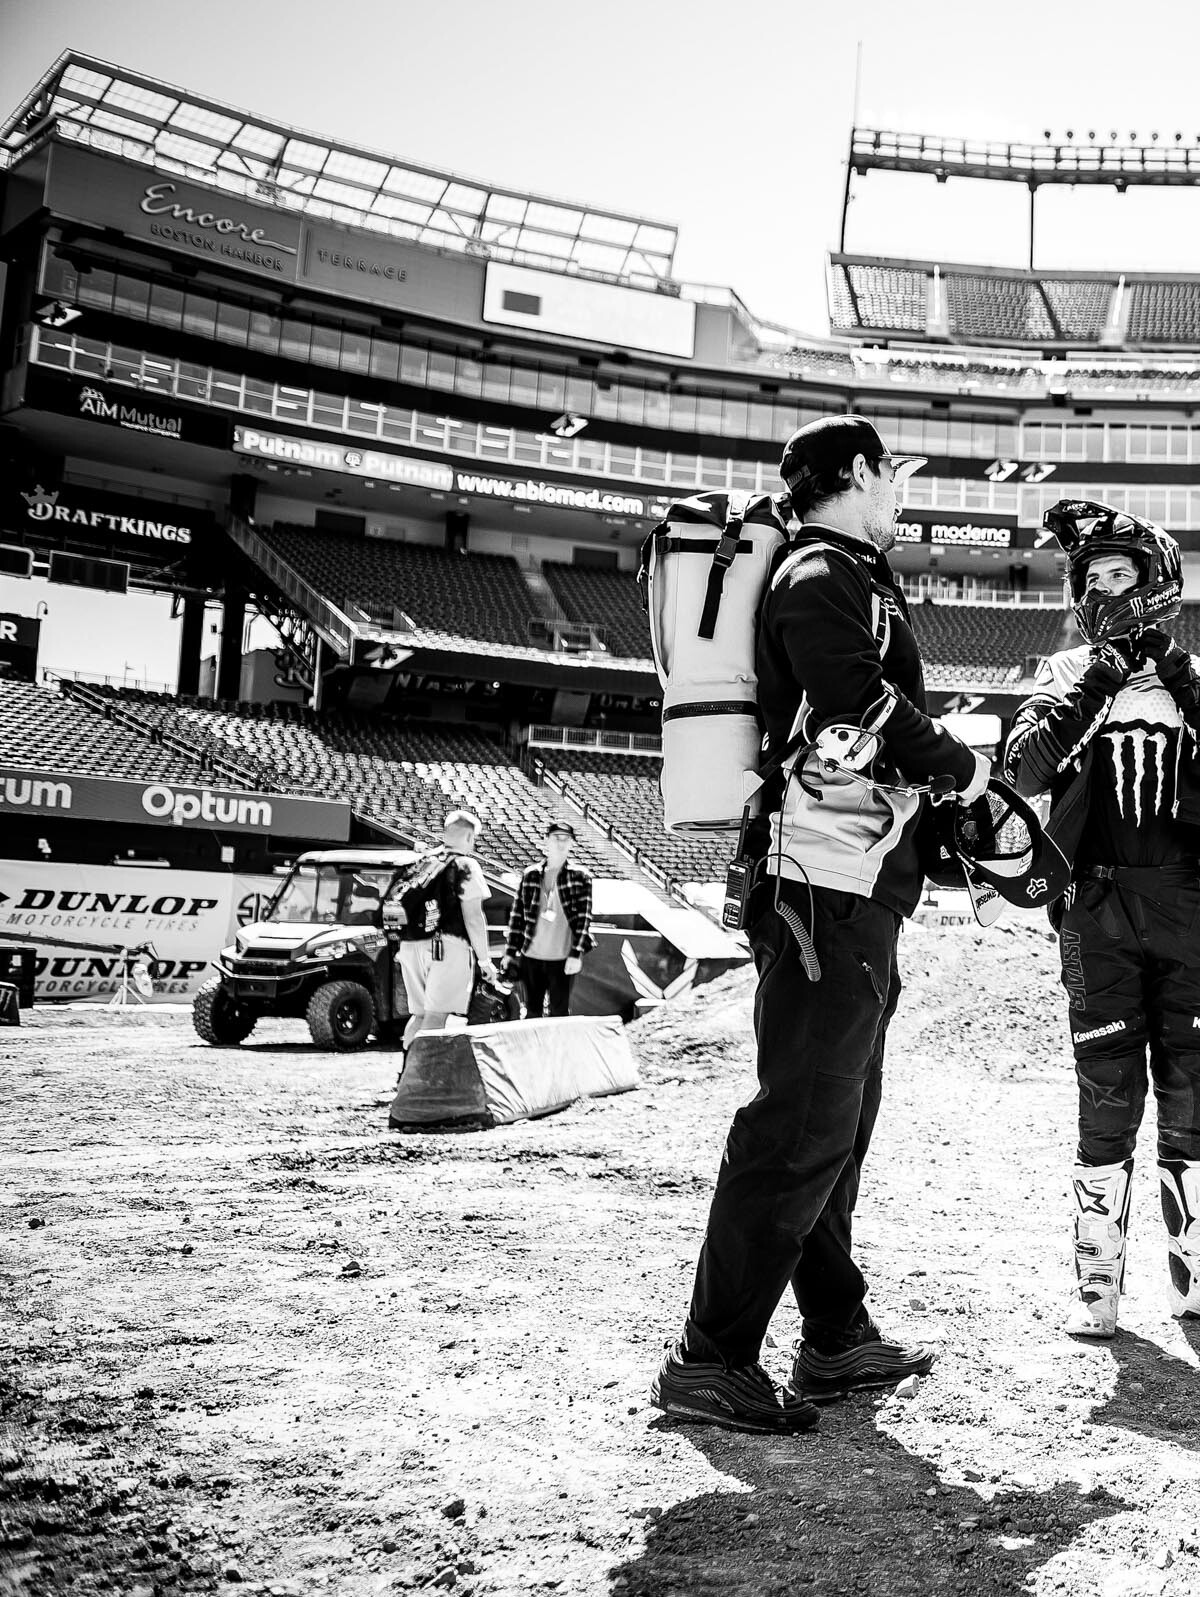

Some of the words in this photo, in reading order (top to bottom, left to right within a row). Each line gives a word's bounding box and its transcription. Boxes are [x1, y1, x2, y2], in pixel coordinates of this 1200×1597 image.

[140, 183, 297, 255] Encore
[150, 223, 215, 252] BOSTON
[220, 243, 284, 272] HARBOR
[318, 248, 408, 282] TERRACE
[120, 405, 182, 432] Mutual
[243, 430, 339, 466] Putnam
[364, 453, 452, 488] Putnam
[456, 473, 644, 515] www.abiomed.com
[931, 523, 1011, 542] moderna
[141, 785, 272, 826] Optum
[15, 889, 218, 917] DUNLOP
[6, 912, 132, 930] MOTORCYCLE
[144, 914, 199, 932] TIRES
[1073, 1019, 1127, 1045] Kawasaki
